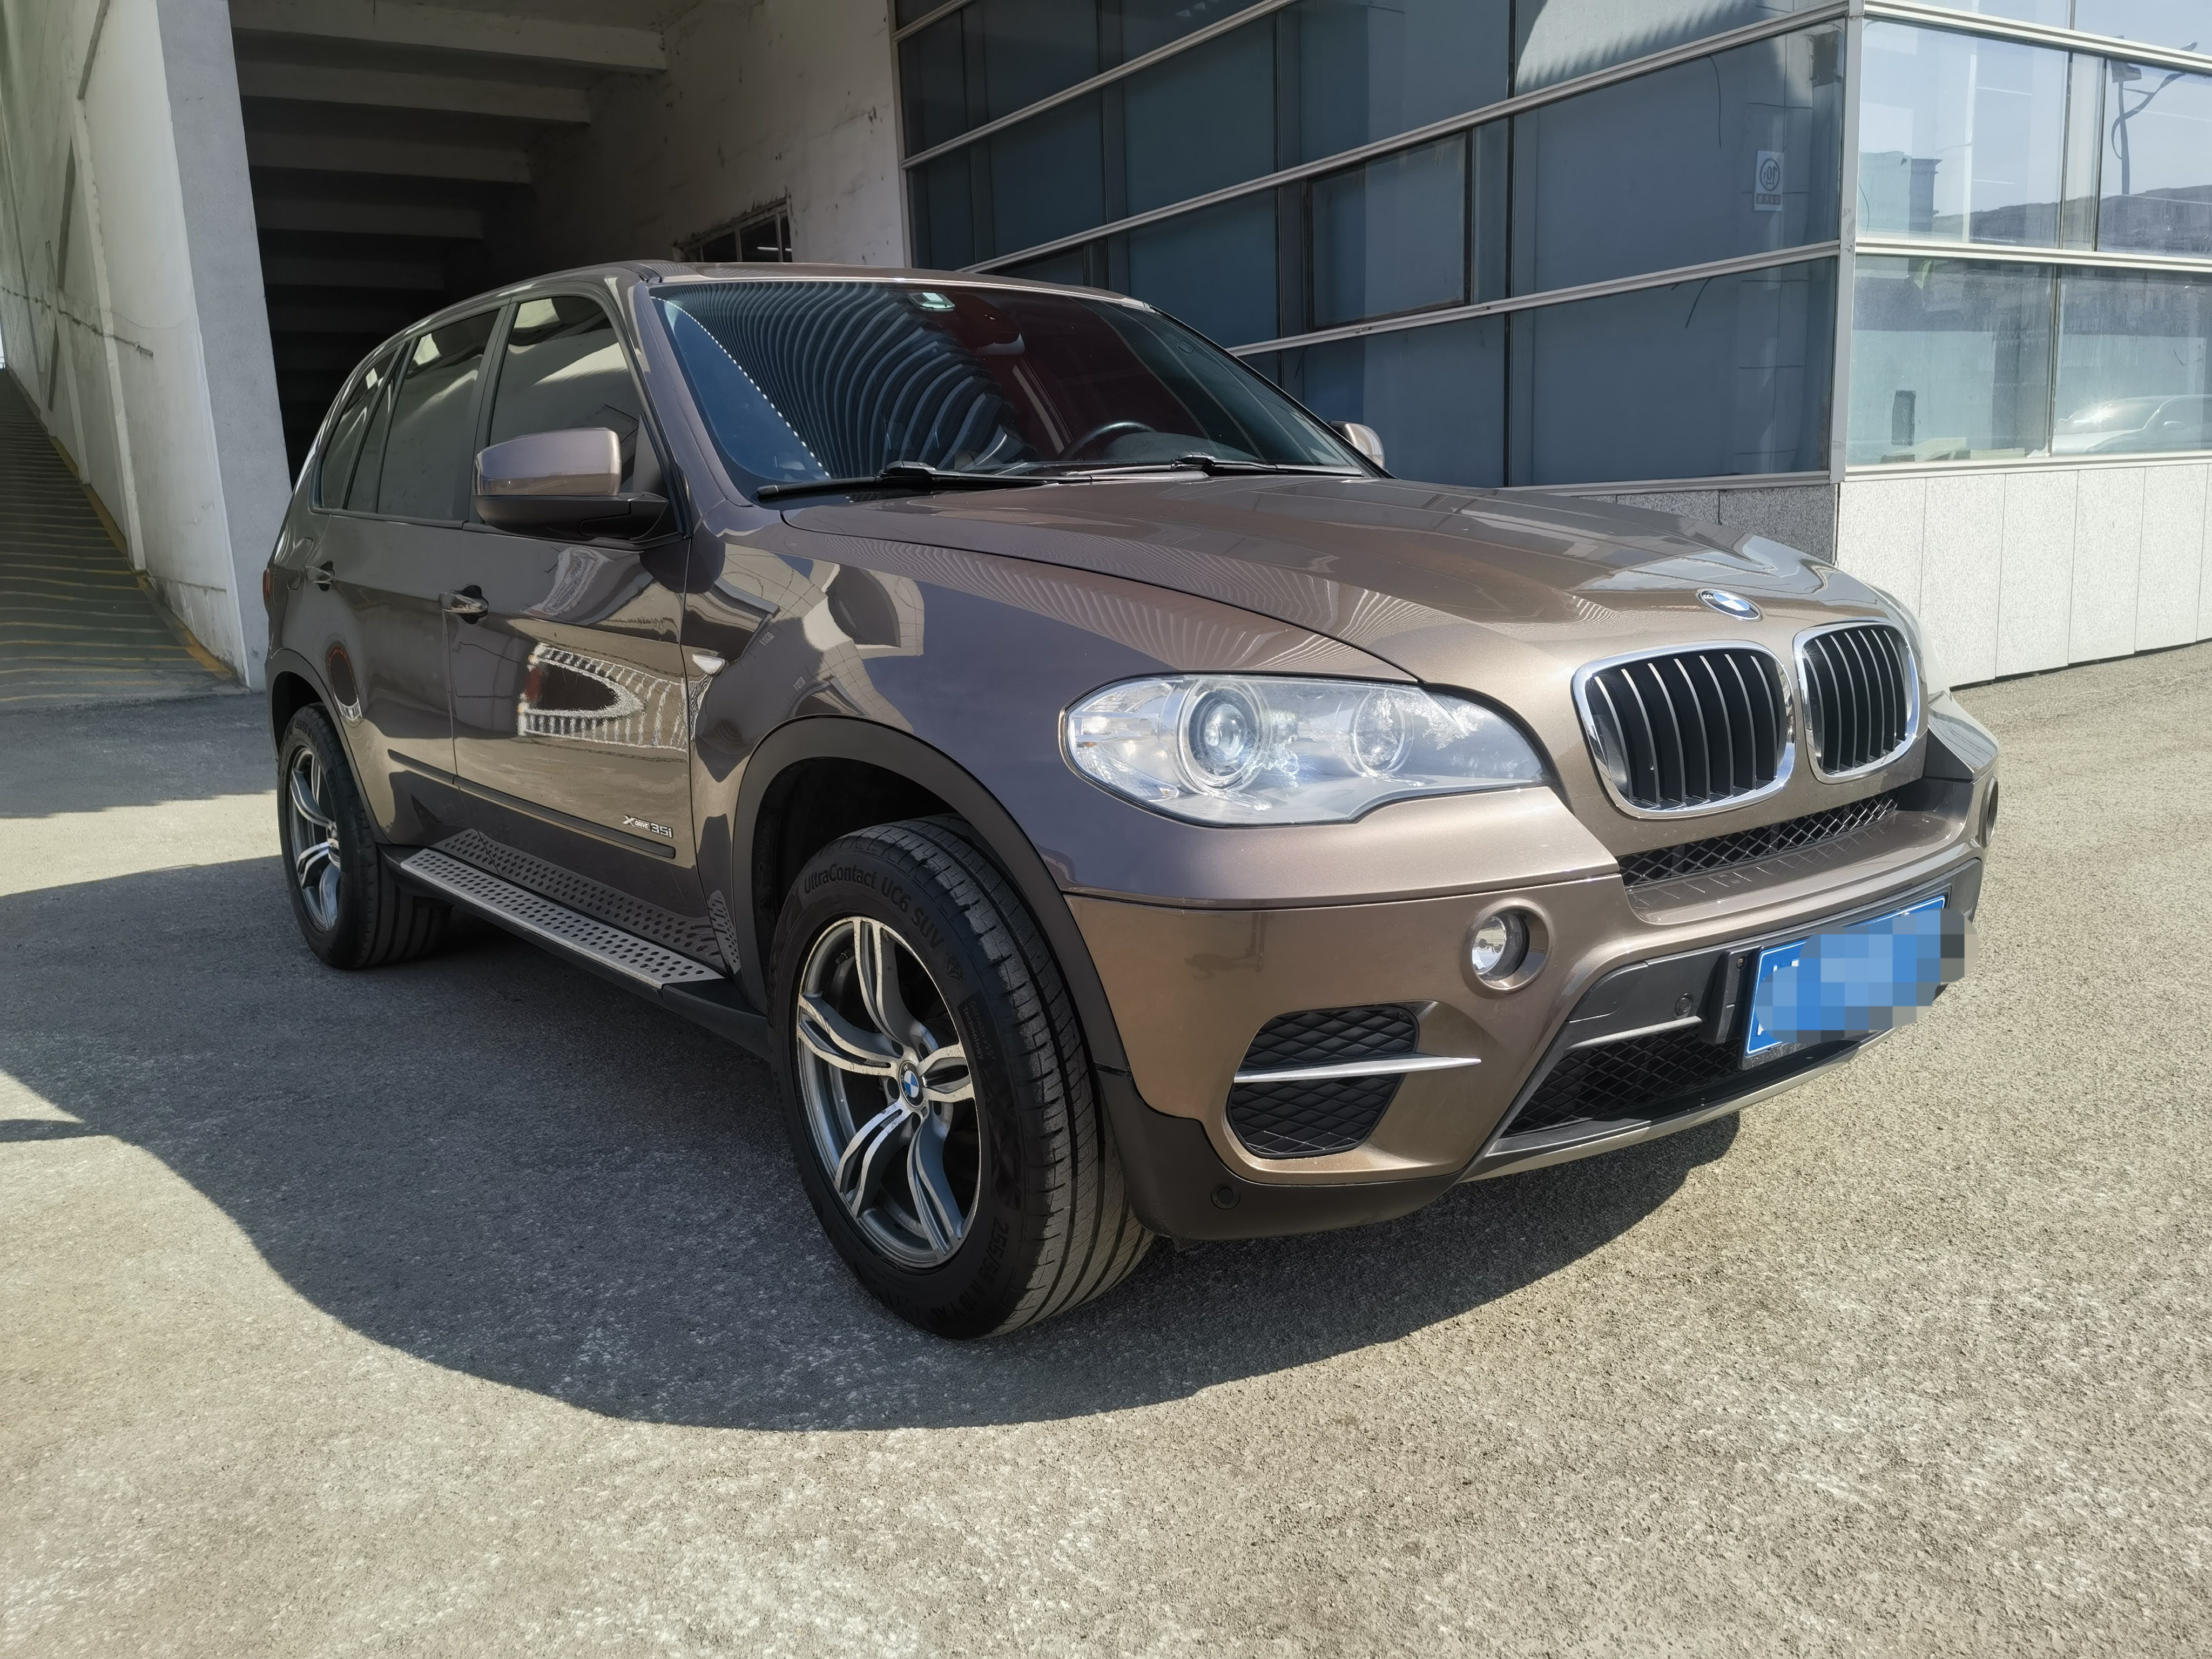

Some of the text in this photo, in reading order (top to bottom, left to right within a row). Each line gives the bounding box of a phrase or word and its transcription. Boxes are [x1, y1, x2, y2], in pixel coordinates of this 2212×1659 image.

[650, 822, 672, 838] 35i
[804, 863, 945, 950] UltraContact UC6 SUV
[963, 1005, 984, 1060] Technology
